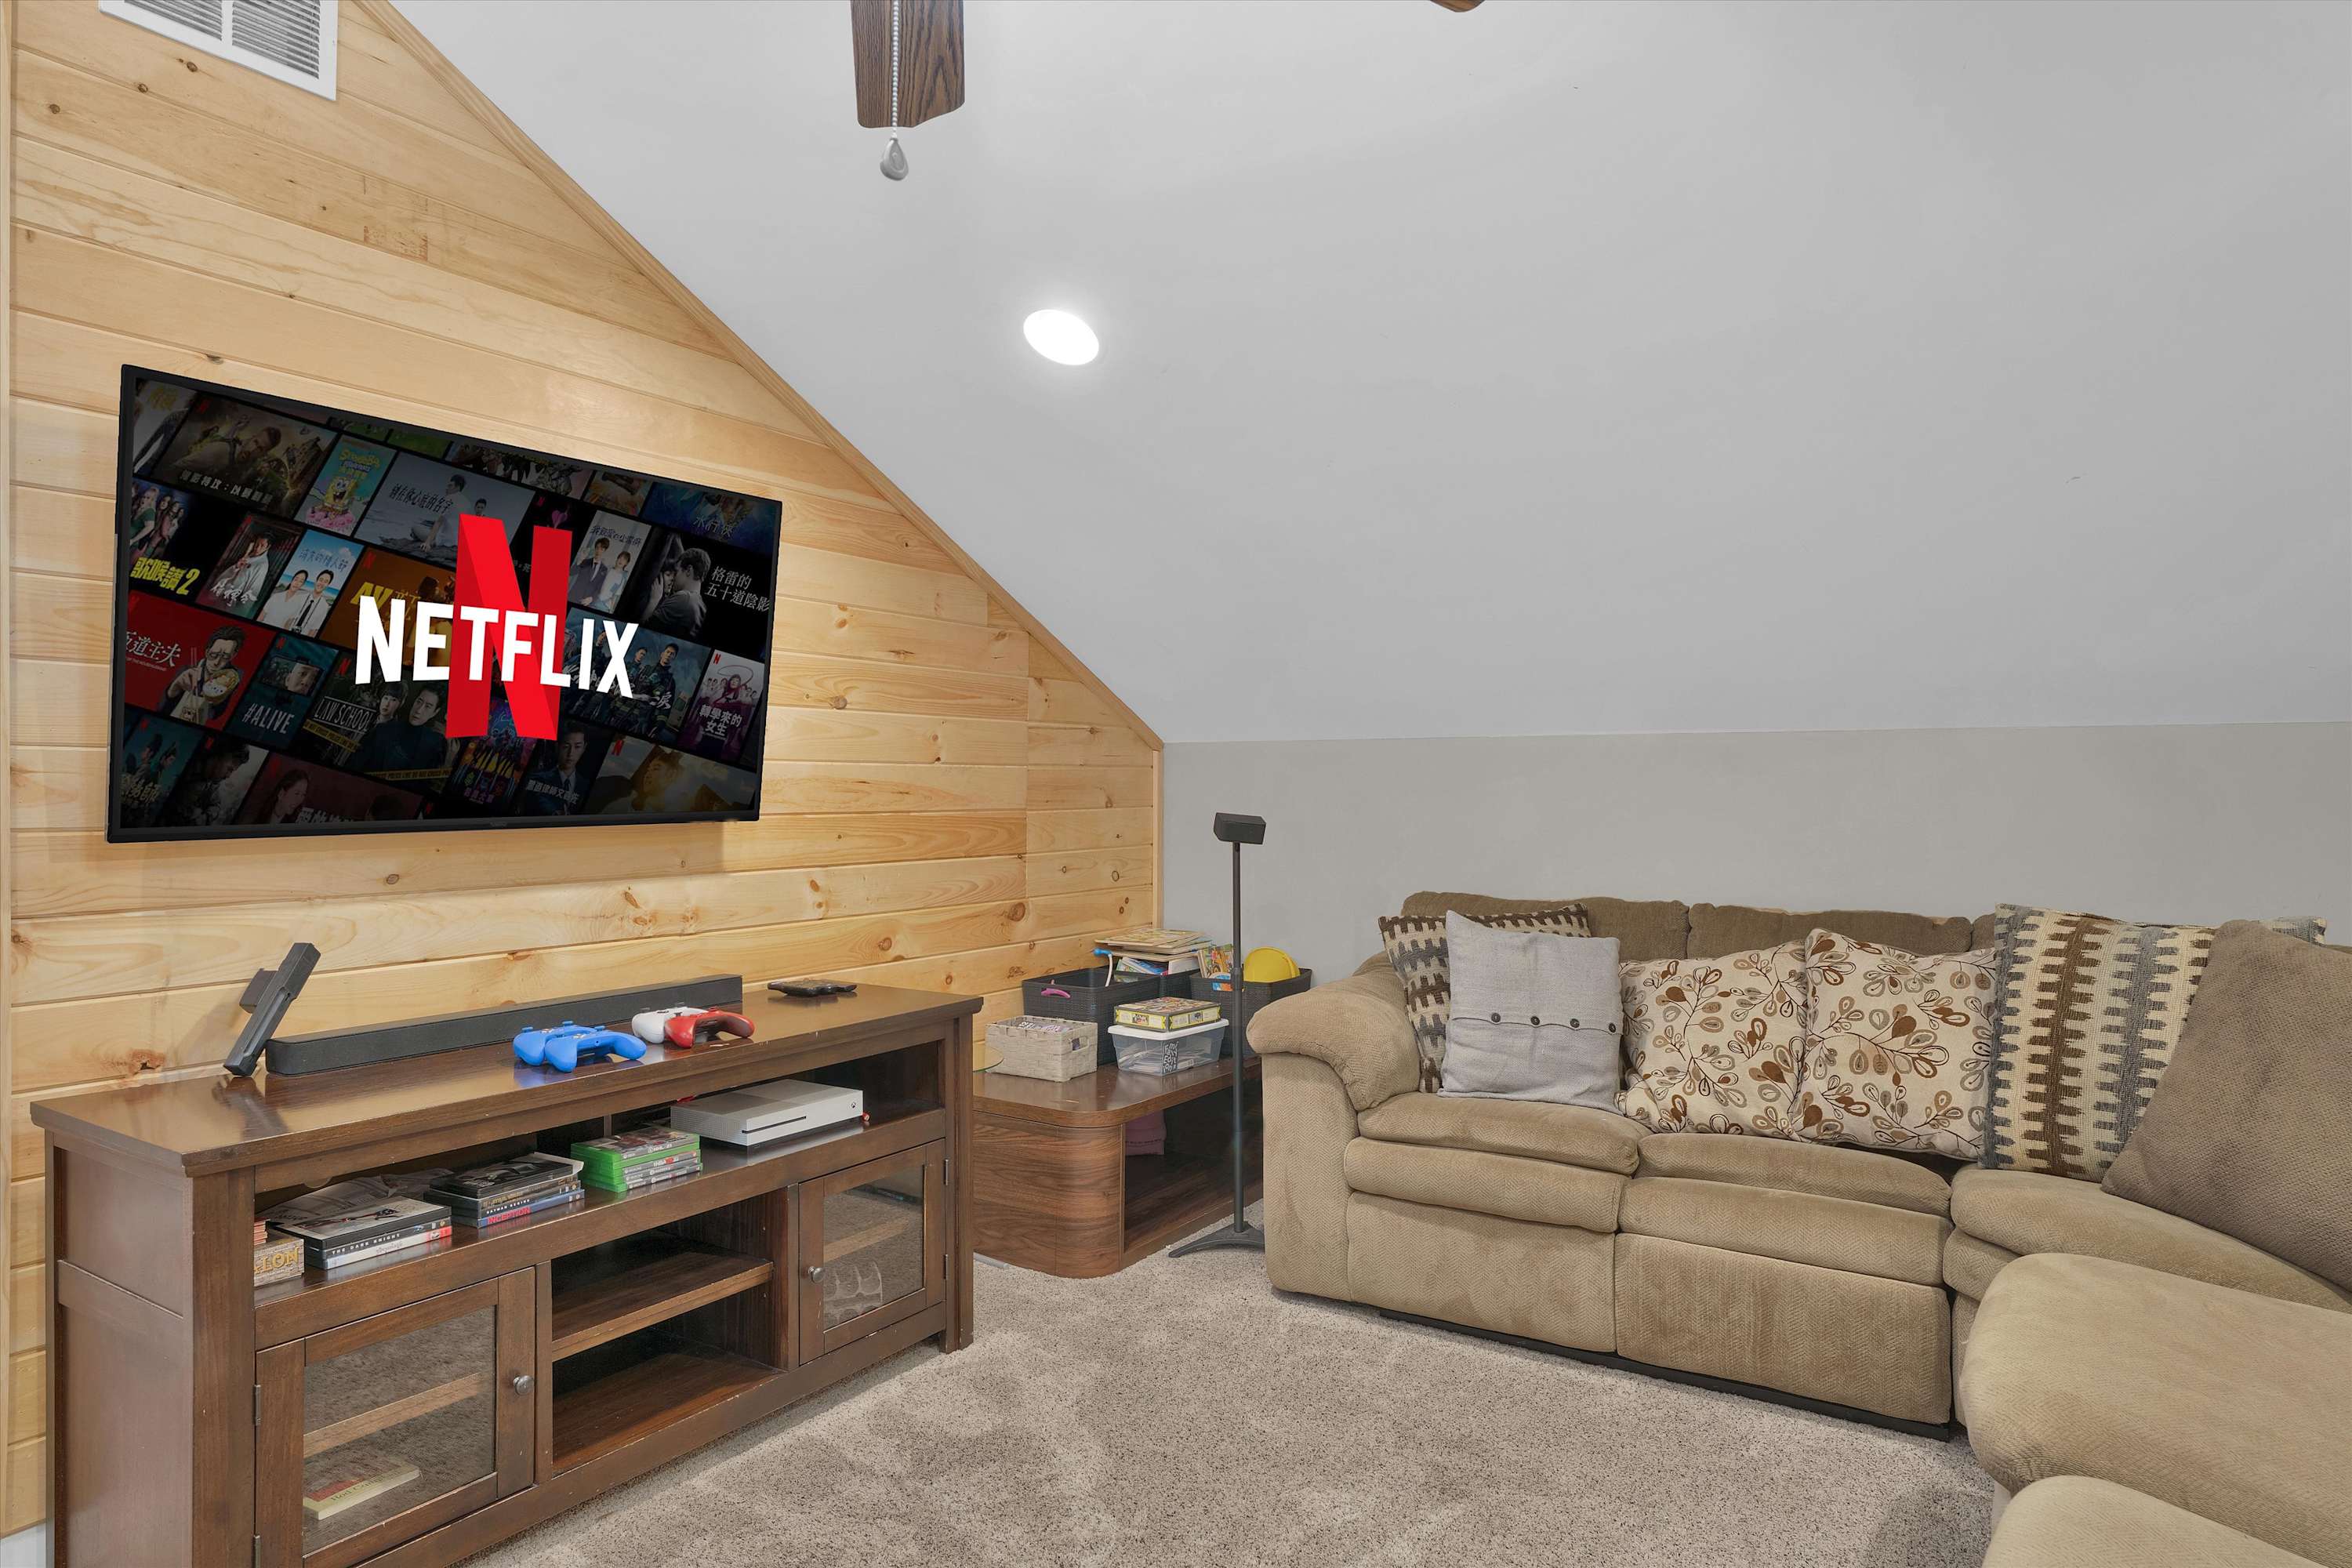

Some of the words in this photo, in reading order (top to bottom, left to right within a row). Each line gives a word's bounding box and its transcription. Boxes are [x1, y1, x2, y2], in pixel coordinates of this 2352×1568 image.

[711, 565, 752, 590] 格雷的
[355, 594, 640, 699] NETFLIX
[241, 702, 296, 735] #ALIVE
[314, 699, 340, 722] LAW
[334, 704, 373, 732] SCHOOL
[705, 720, 728, 737] 女生
[488, 1207, 532, 1224] INCEPTION
[350, 1241, 370, 1250] DARK
[373, 1233, 401, 1243] KNIGHT
